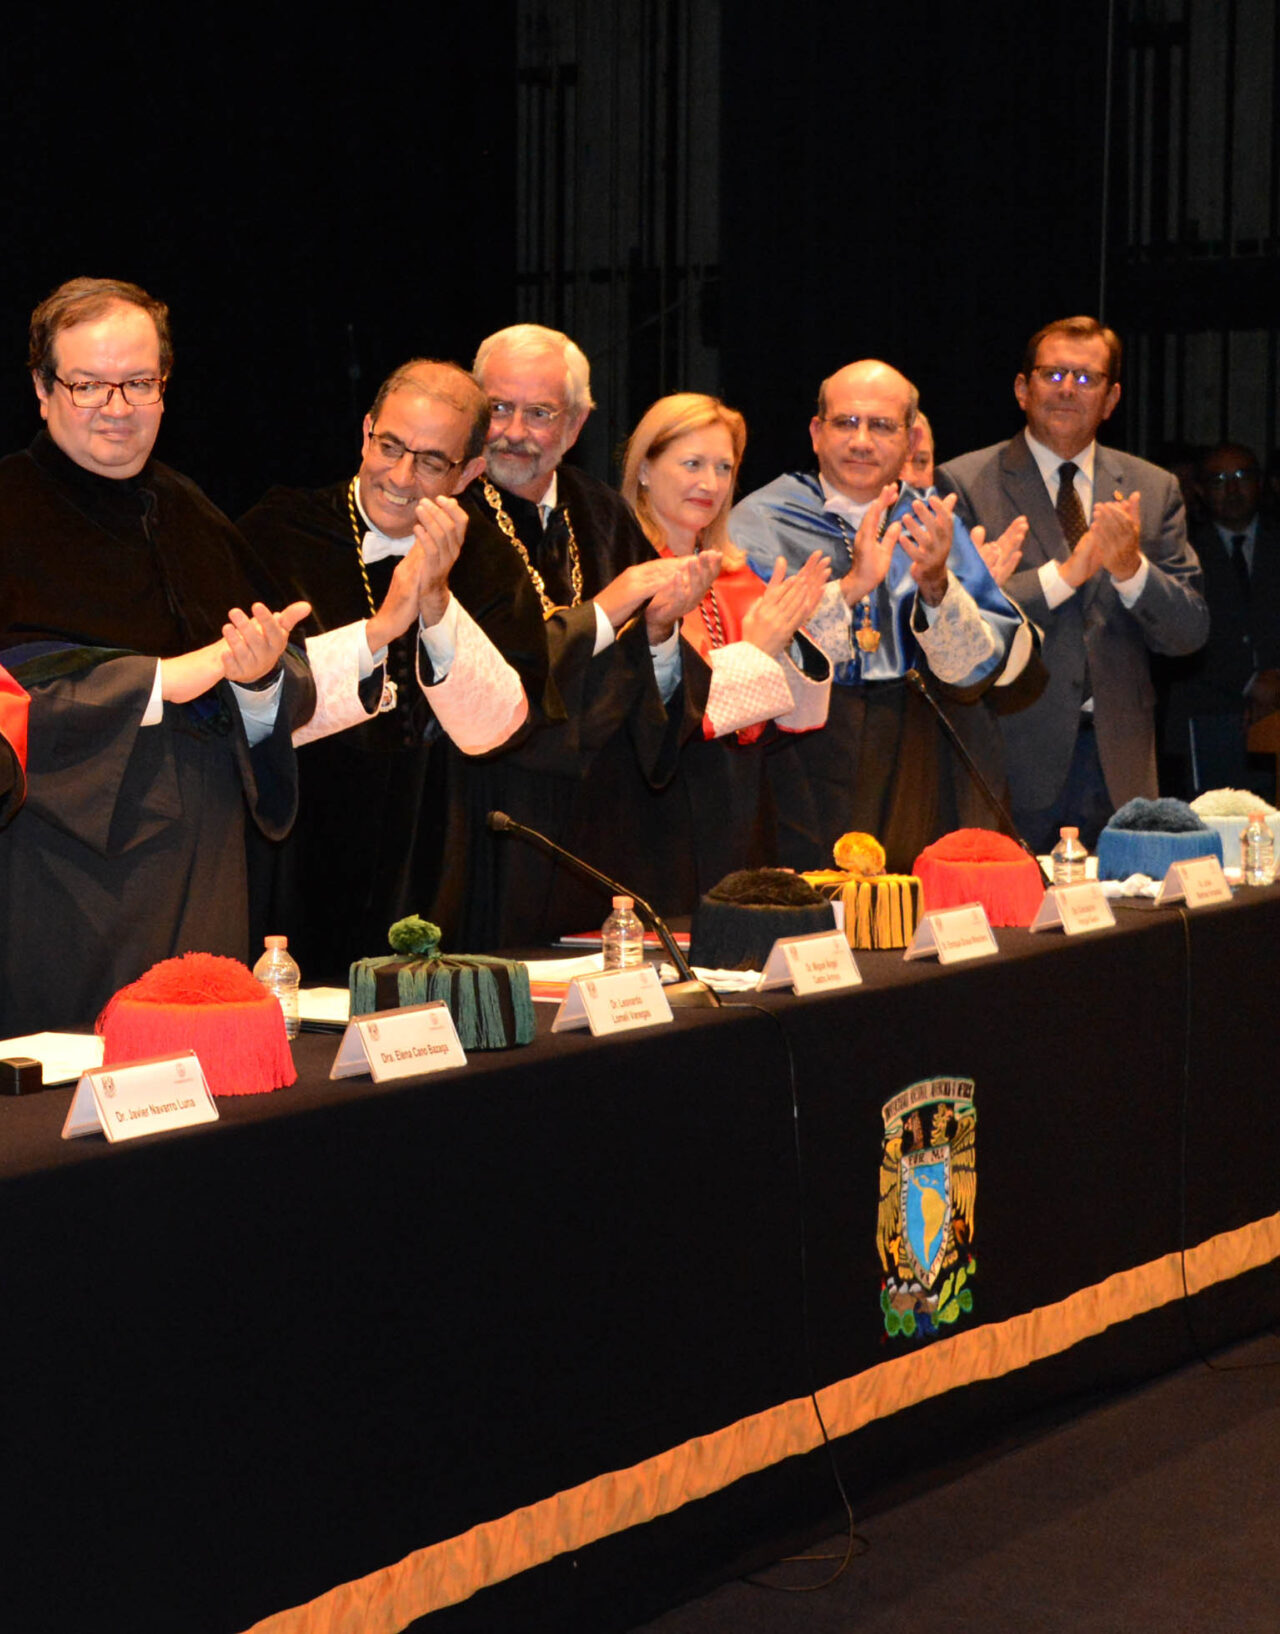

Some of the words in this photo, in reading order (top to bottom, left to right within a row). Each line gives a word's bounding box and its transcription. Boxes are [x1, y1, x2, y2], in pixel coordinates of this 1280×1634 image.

[395, 1050, 412, 1060] Elena
[412, 1047, 428, 1057] Cano
[115, 1111, 128, 1122] Dr.
[128, 1108, 148, 1120] Javier
[148, 1103, 177, 1114] Navarro
[176, 1099, 195, 1110] Luna
